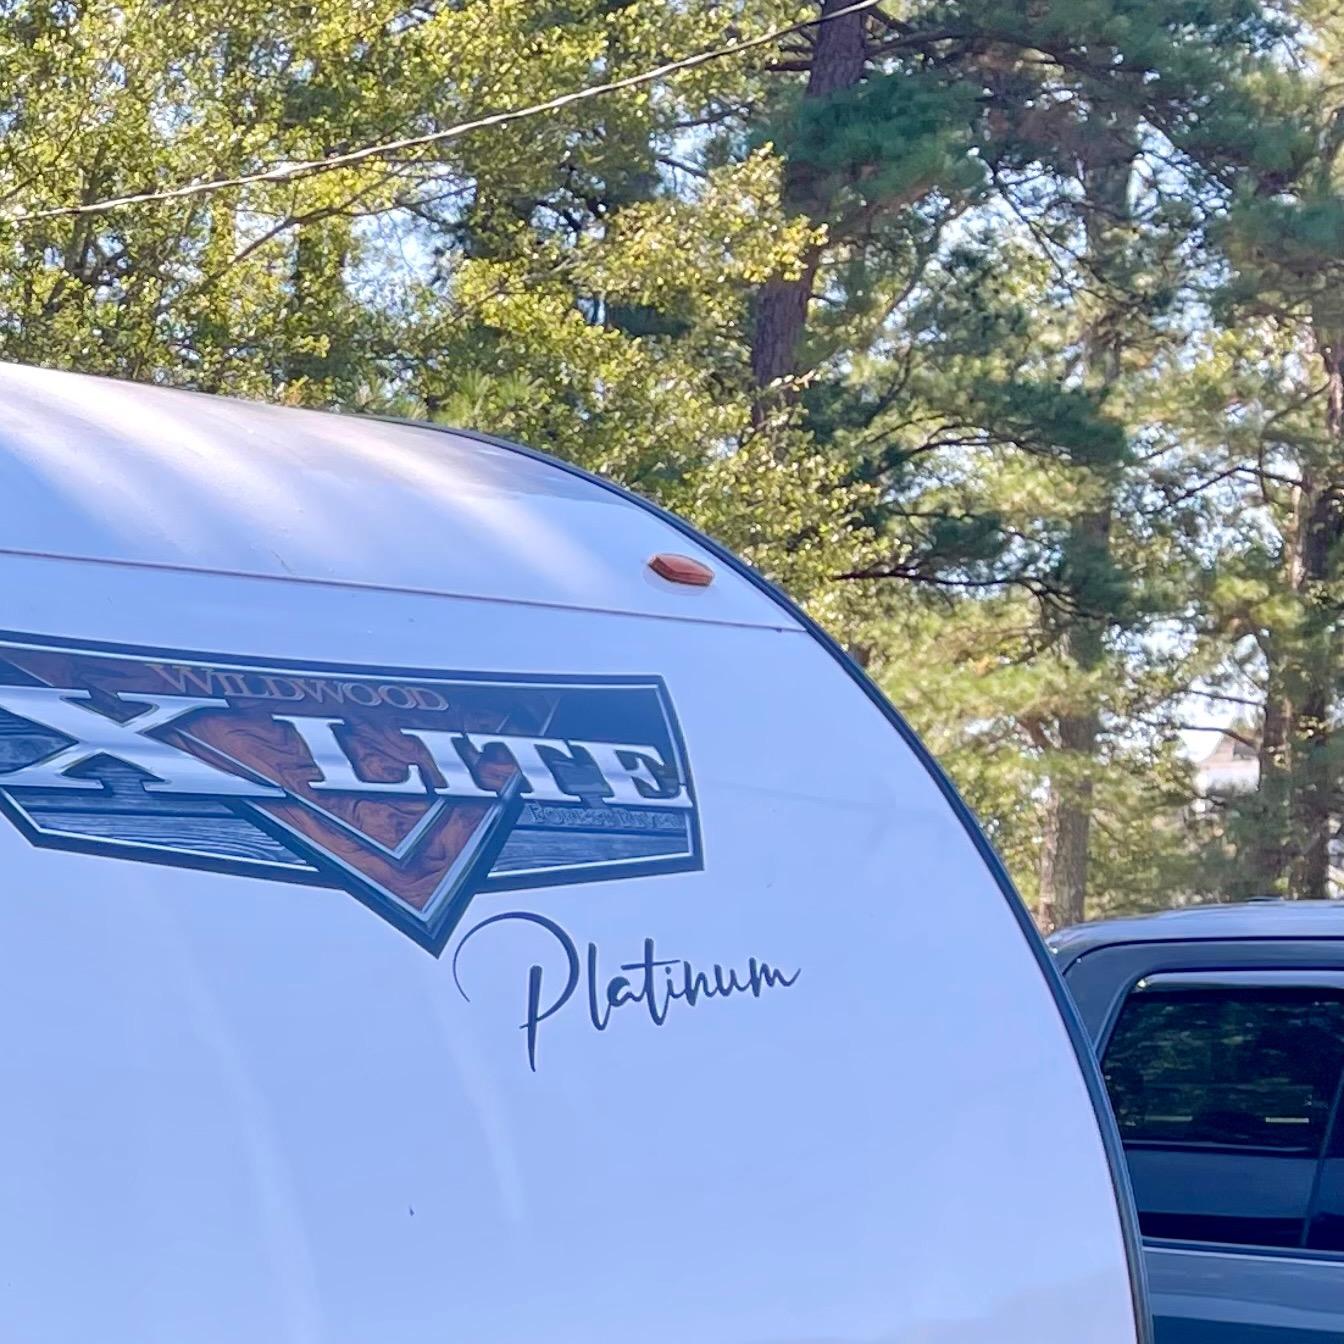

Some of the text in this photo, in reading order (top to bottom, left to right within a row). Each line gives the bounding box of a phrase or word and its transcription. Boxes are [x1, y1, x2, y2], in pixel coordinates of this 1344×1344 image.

[145, 662, 450, 712] WILDWOOD
[271, 714, 692, 808] LITE
[452, 911, 802, 1072] Platinum
